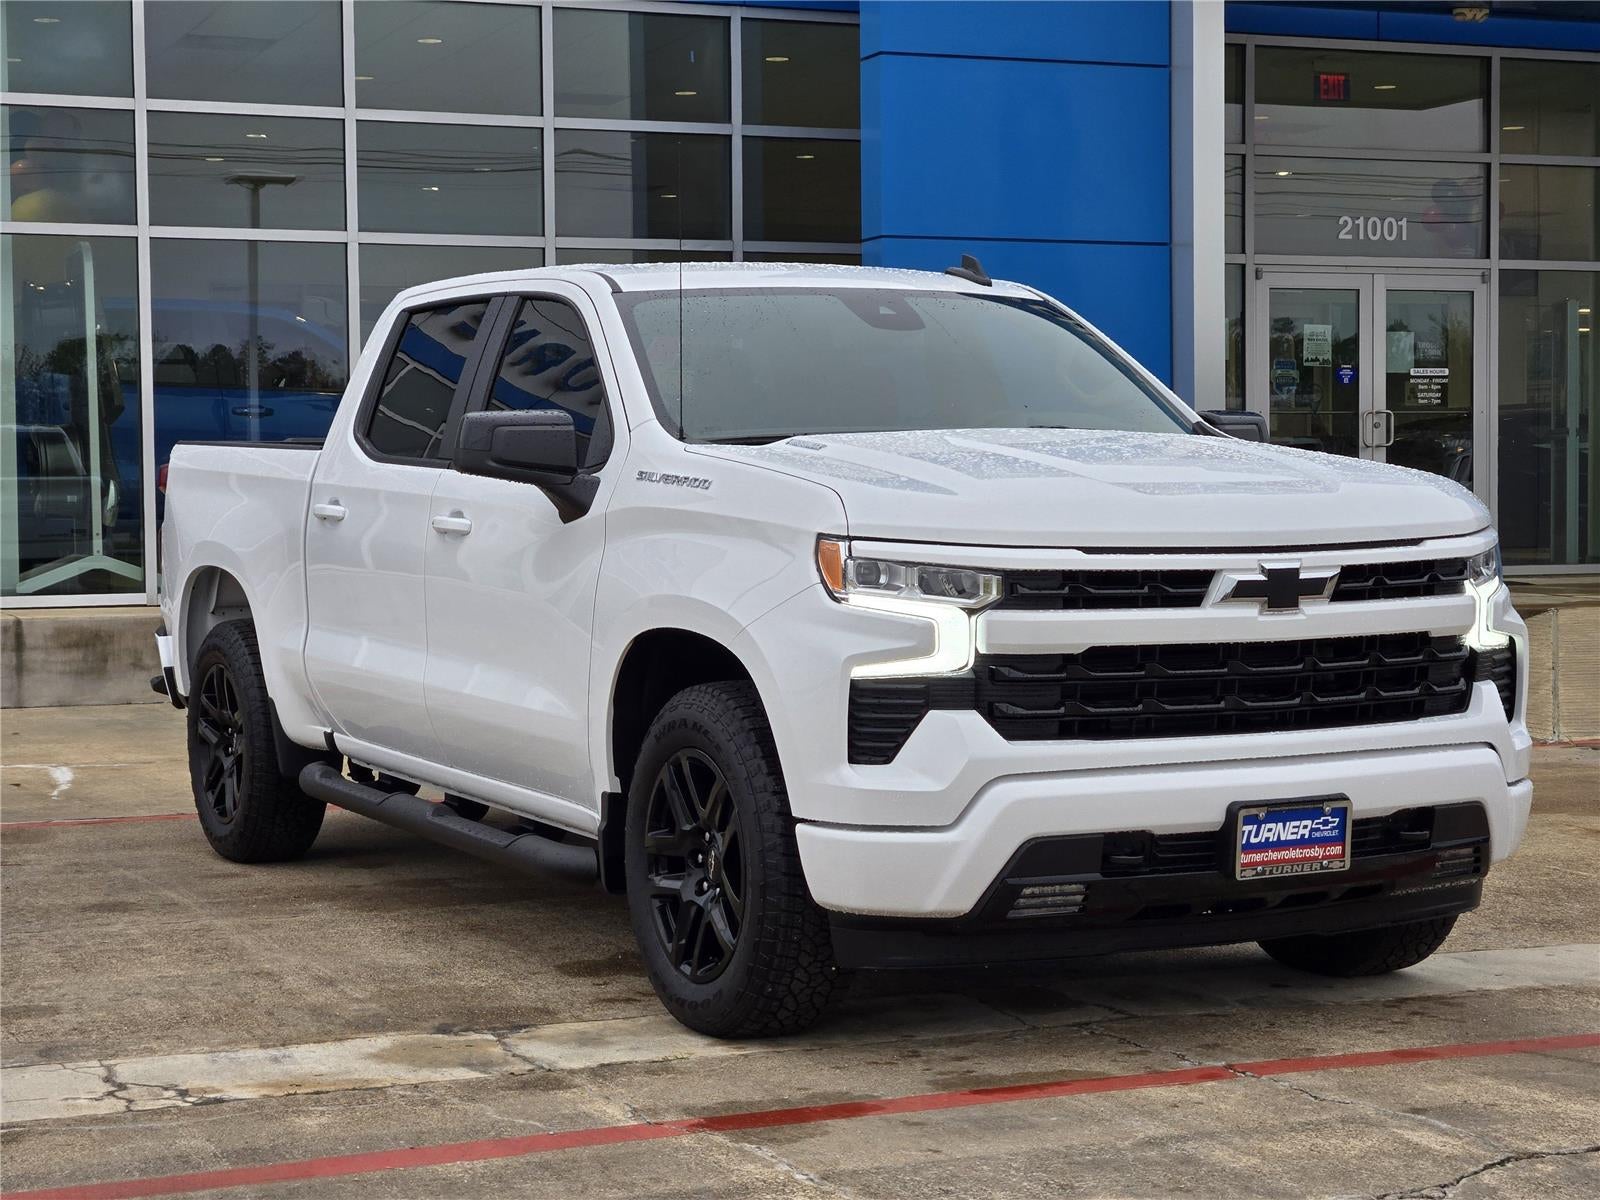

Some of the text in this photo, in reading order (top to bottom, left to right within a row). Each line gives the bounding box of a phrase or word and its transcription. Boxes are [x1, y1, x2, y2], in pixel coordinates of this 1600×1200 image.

[1319, 74, 1345, 100] EXIT
[1337, 215, 1409, 241] 21001
[636, 470, 713, 490] SILVERADO
[1241, 820, 1312, 844] TURNER
[1311, 829, 1339, 838] CHEVROLET
[1240, 845, 1342, 863] turnerchevroletcrosby.com
[1263, 862, 1321, 875] TURNER
